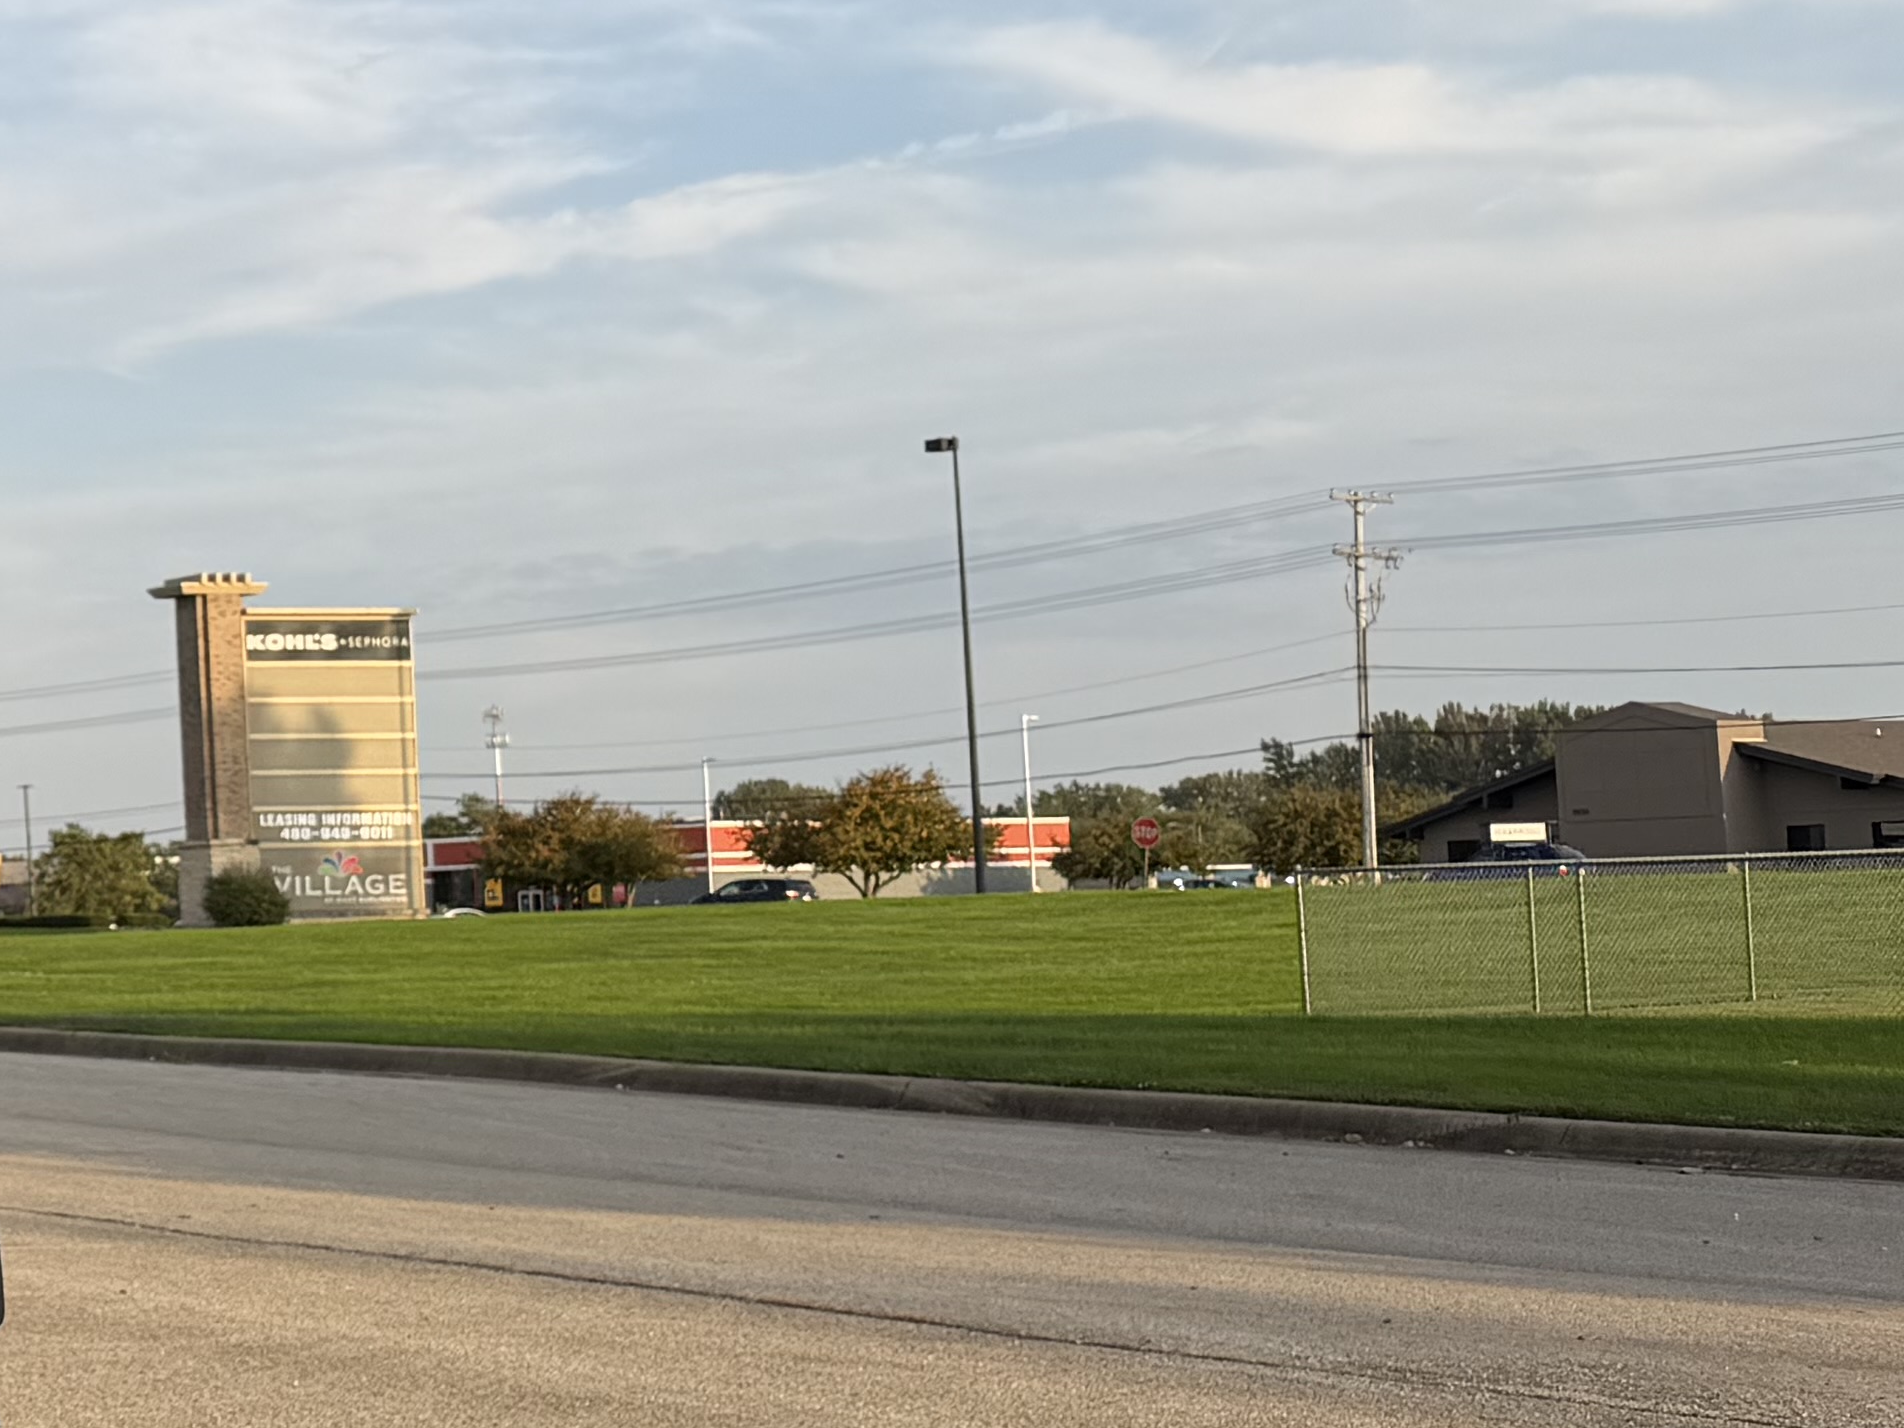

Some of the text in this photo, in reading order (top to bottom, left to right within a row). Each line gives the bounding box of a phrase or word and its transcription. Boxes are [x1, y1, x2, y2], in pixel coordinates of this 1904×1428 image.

[246, 633, 409, 651] KOHL'S SEPHORA
[259, 811, 412, 827] LEASING INFORMATION
[274, 873, 408, 896] VILLAGE
